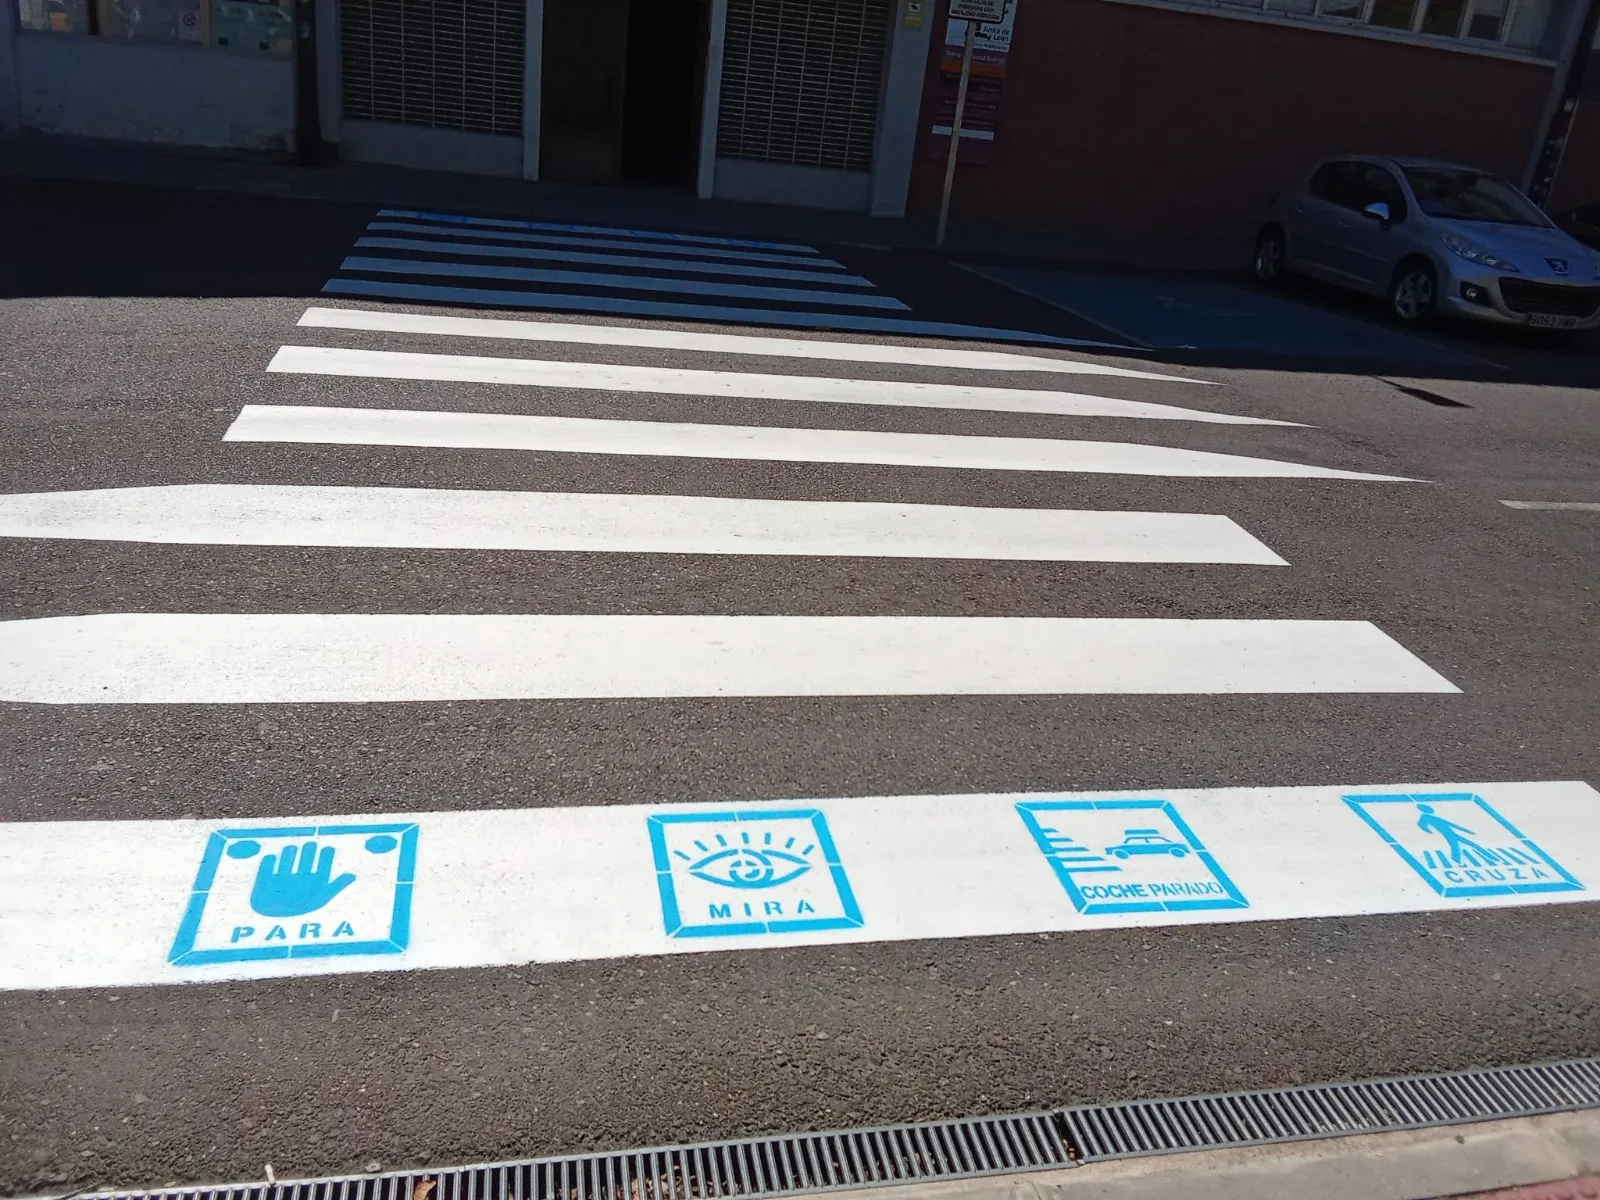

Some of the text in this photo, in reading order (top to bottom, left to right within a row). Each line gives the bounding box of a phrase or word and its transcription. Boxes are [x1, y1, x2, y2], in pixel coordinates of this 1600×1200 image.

[1444, 867, 1549, 883] CRUZA
[1080, 881, 1224, 899] COCHE PARADO
[708, 899, 816, 919] MIRA
[230, 920, 355, 943] PARA
